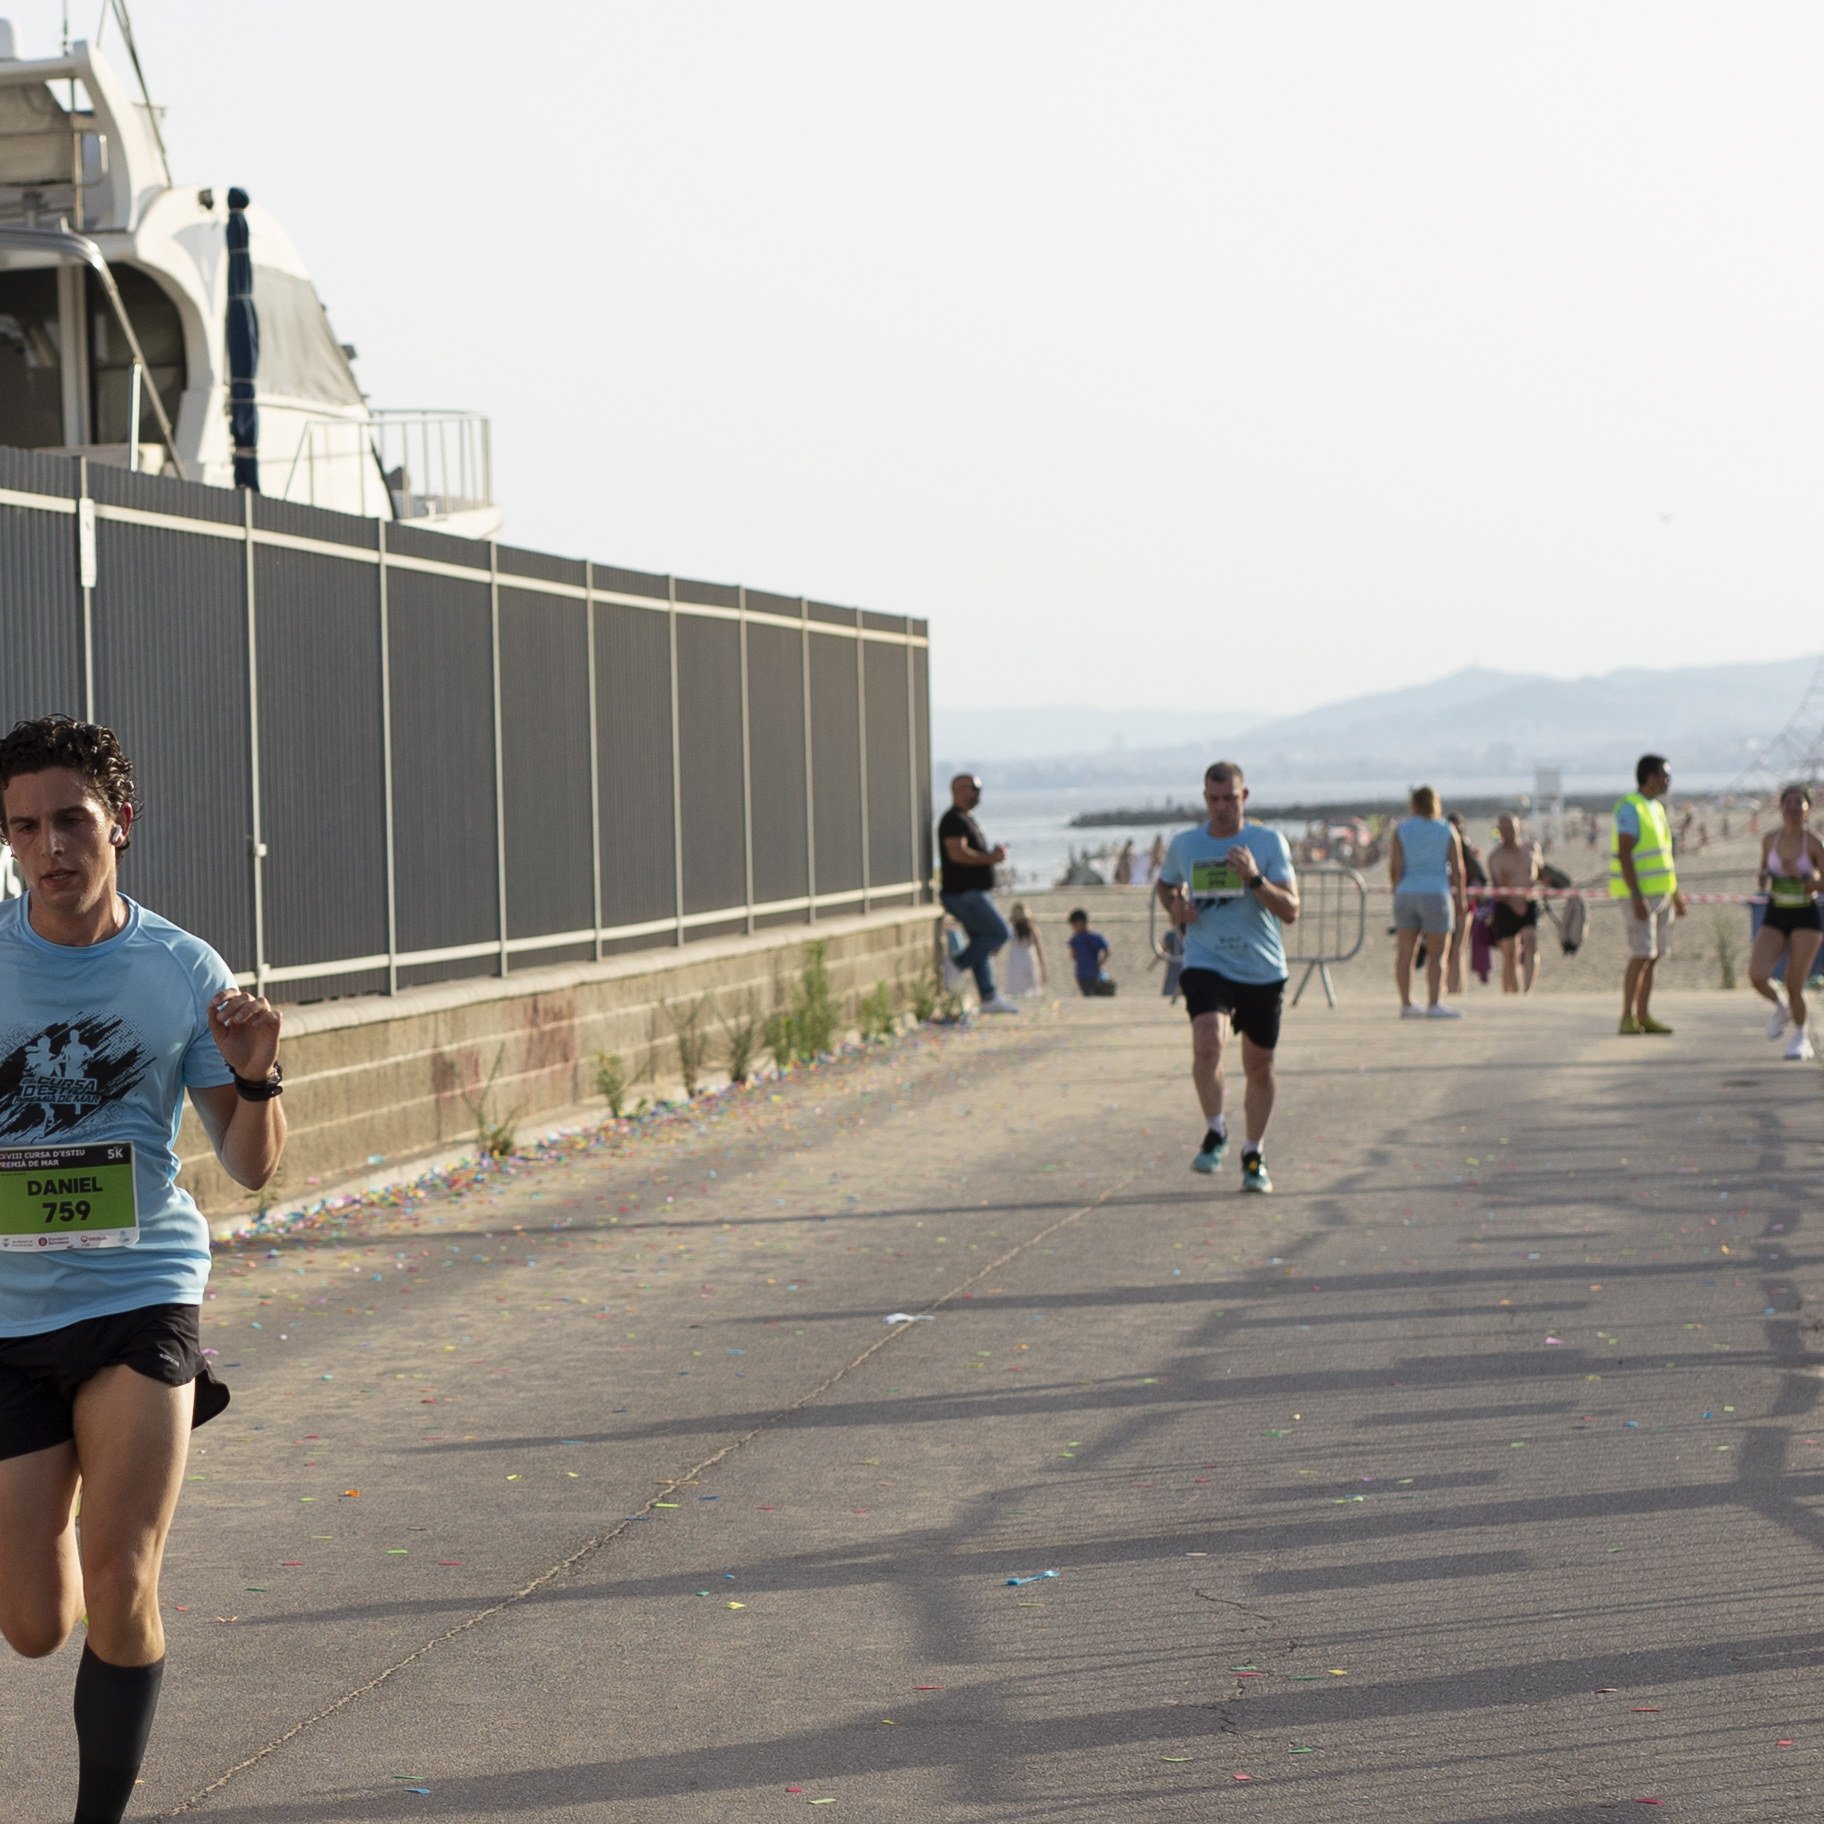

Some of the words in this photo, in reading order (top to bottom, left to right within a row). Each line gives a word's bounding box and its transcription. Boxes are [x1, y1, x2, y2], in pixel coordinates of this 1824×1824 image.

[37, 1076, 96, 1091] CURSA
[24, 1150, 51, 1160] CURSA
[52, 1149, 86, 1158] D'ESTIU
[107, 1148, 124, 1159] 5K
[27, 1176, 104, 1196] DANIEL
[42, 1200, 91, 1224] 759
